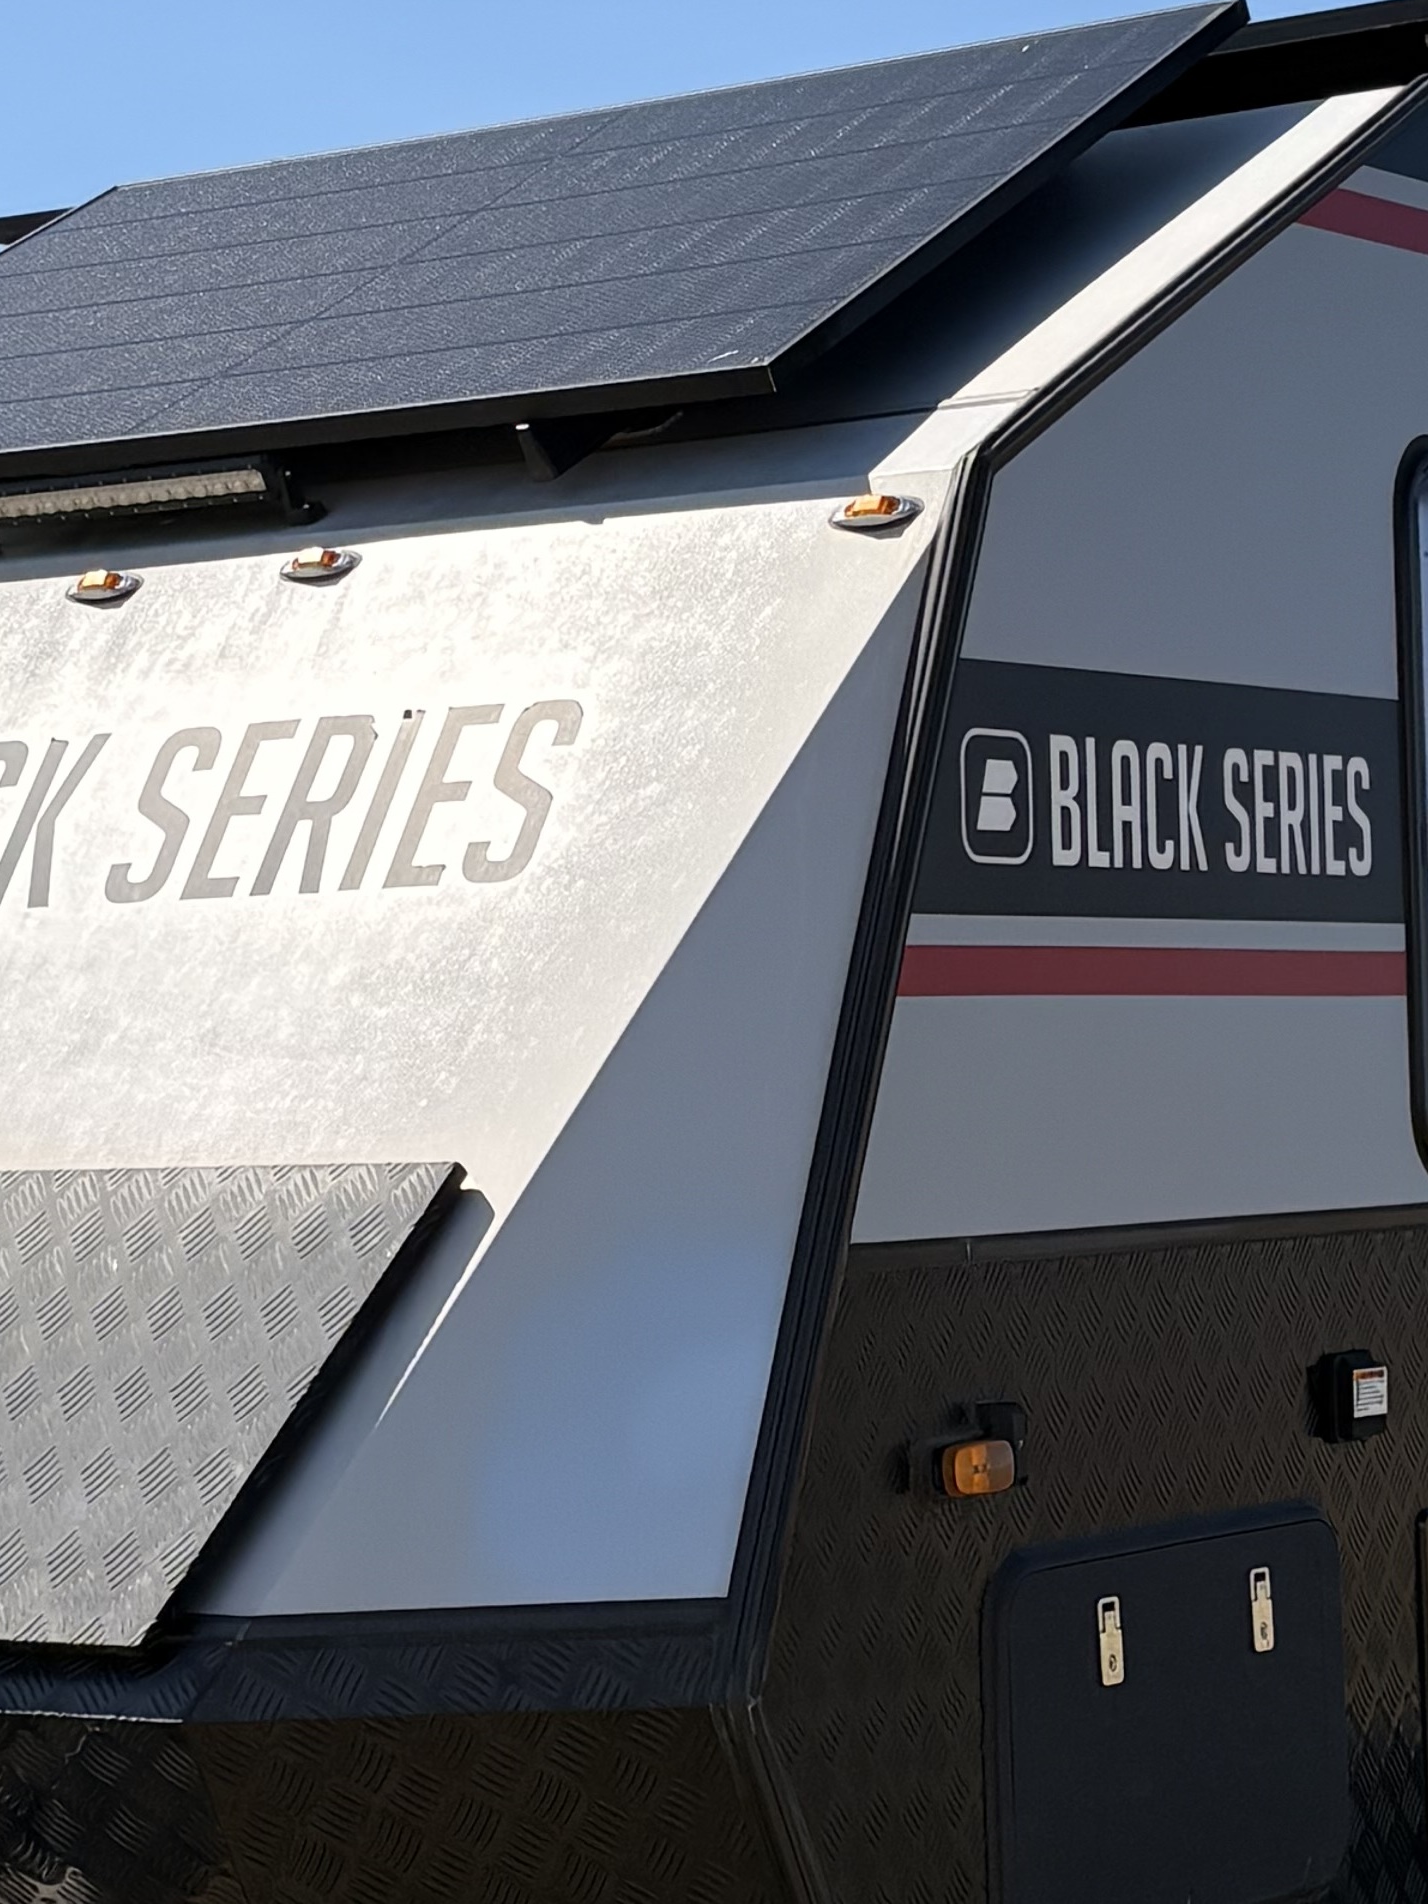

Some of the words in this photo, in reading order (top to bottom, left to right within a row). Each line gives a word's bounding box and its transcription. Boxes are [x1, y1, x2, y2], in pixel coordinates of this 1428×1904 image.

[103, 699, 584, 905] SERIES
[1049, 734, 1208, 871] BLACK
[1223, 748, 1372, 876] SERIES
